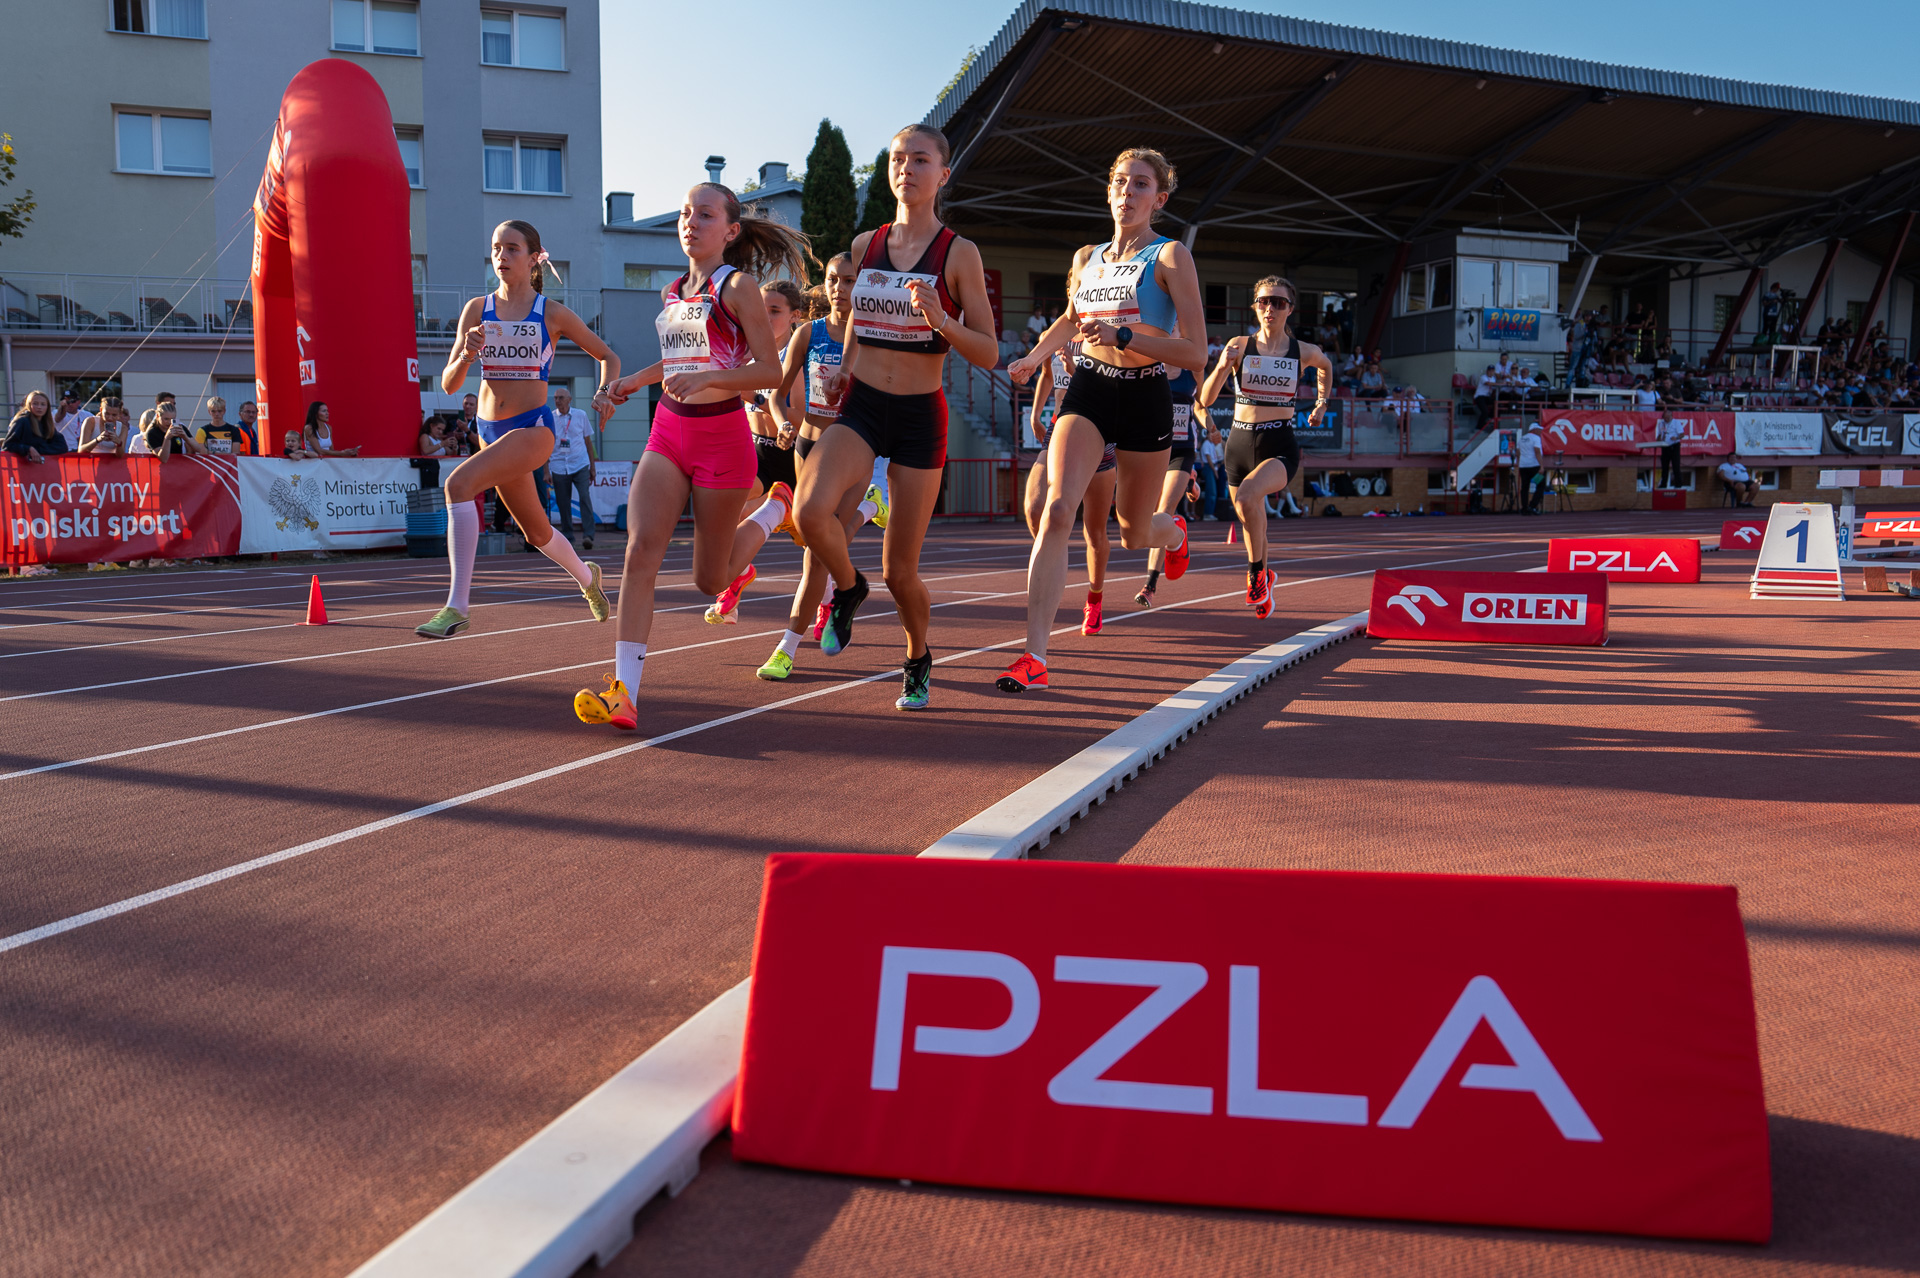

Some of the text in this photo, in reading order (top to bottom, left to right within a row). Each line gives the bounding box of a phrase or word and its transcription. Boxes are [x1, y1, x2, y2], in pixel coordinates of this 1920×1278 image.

[1113, 265, 1138, 277] 779
[513, 325, 537, 337] 753
[660, 329, 707, 350] AMIŃSKA
[483, 343, 539, 359] GRADOŃ
[1096, 365, 1138, 380] NIKE
[1139, 362, 1165, 379] PRO
[1273, 360, 1293, 371] 501
[1247, 373, 1291, 387] JAROSZ
[1232, 420, 1254, 431] NIKE
[1255, 420, 1283, 431] PRO
[1580, 423, 1635, 442] ORLEN
[1831, 420, 1894, 447] 4F FUEL
[7, 476, 150, 509] tworzymy
[324, 480, 418, 496] Ministerstwo
[326, 501, 375, 519] Sportu
[379, 500, 384, 515] i
[11, 508, 182, 546] polski sport
[1785, 519, 1810, 564] 1
[1839, 528, 1848, 558] DIMA
[1568, 550, 1680, 573] PZLA
[1469, 597, 1579, 620] ORLEN
[870, 945, 1603, 1143] PZLA
